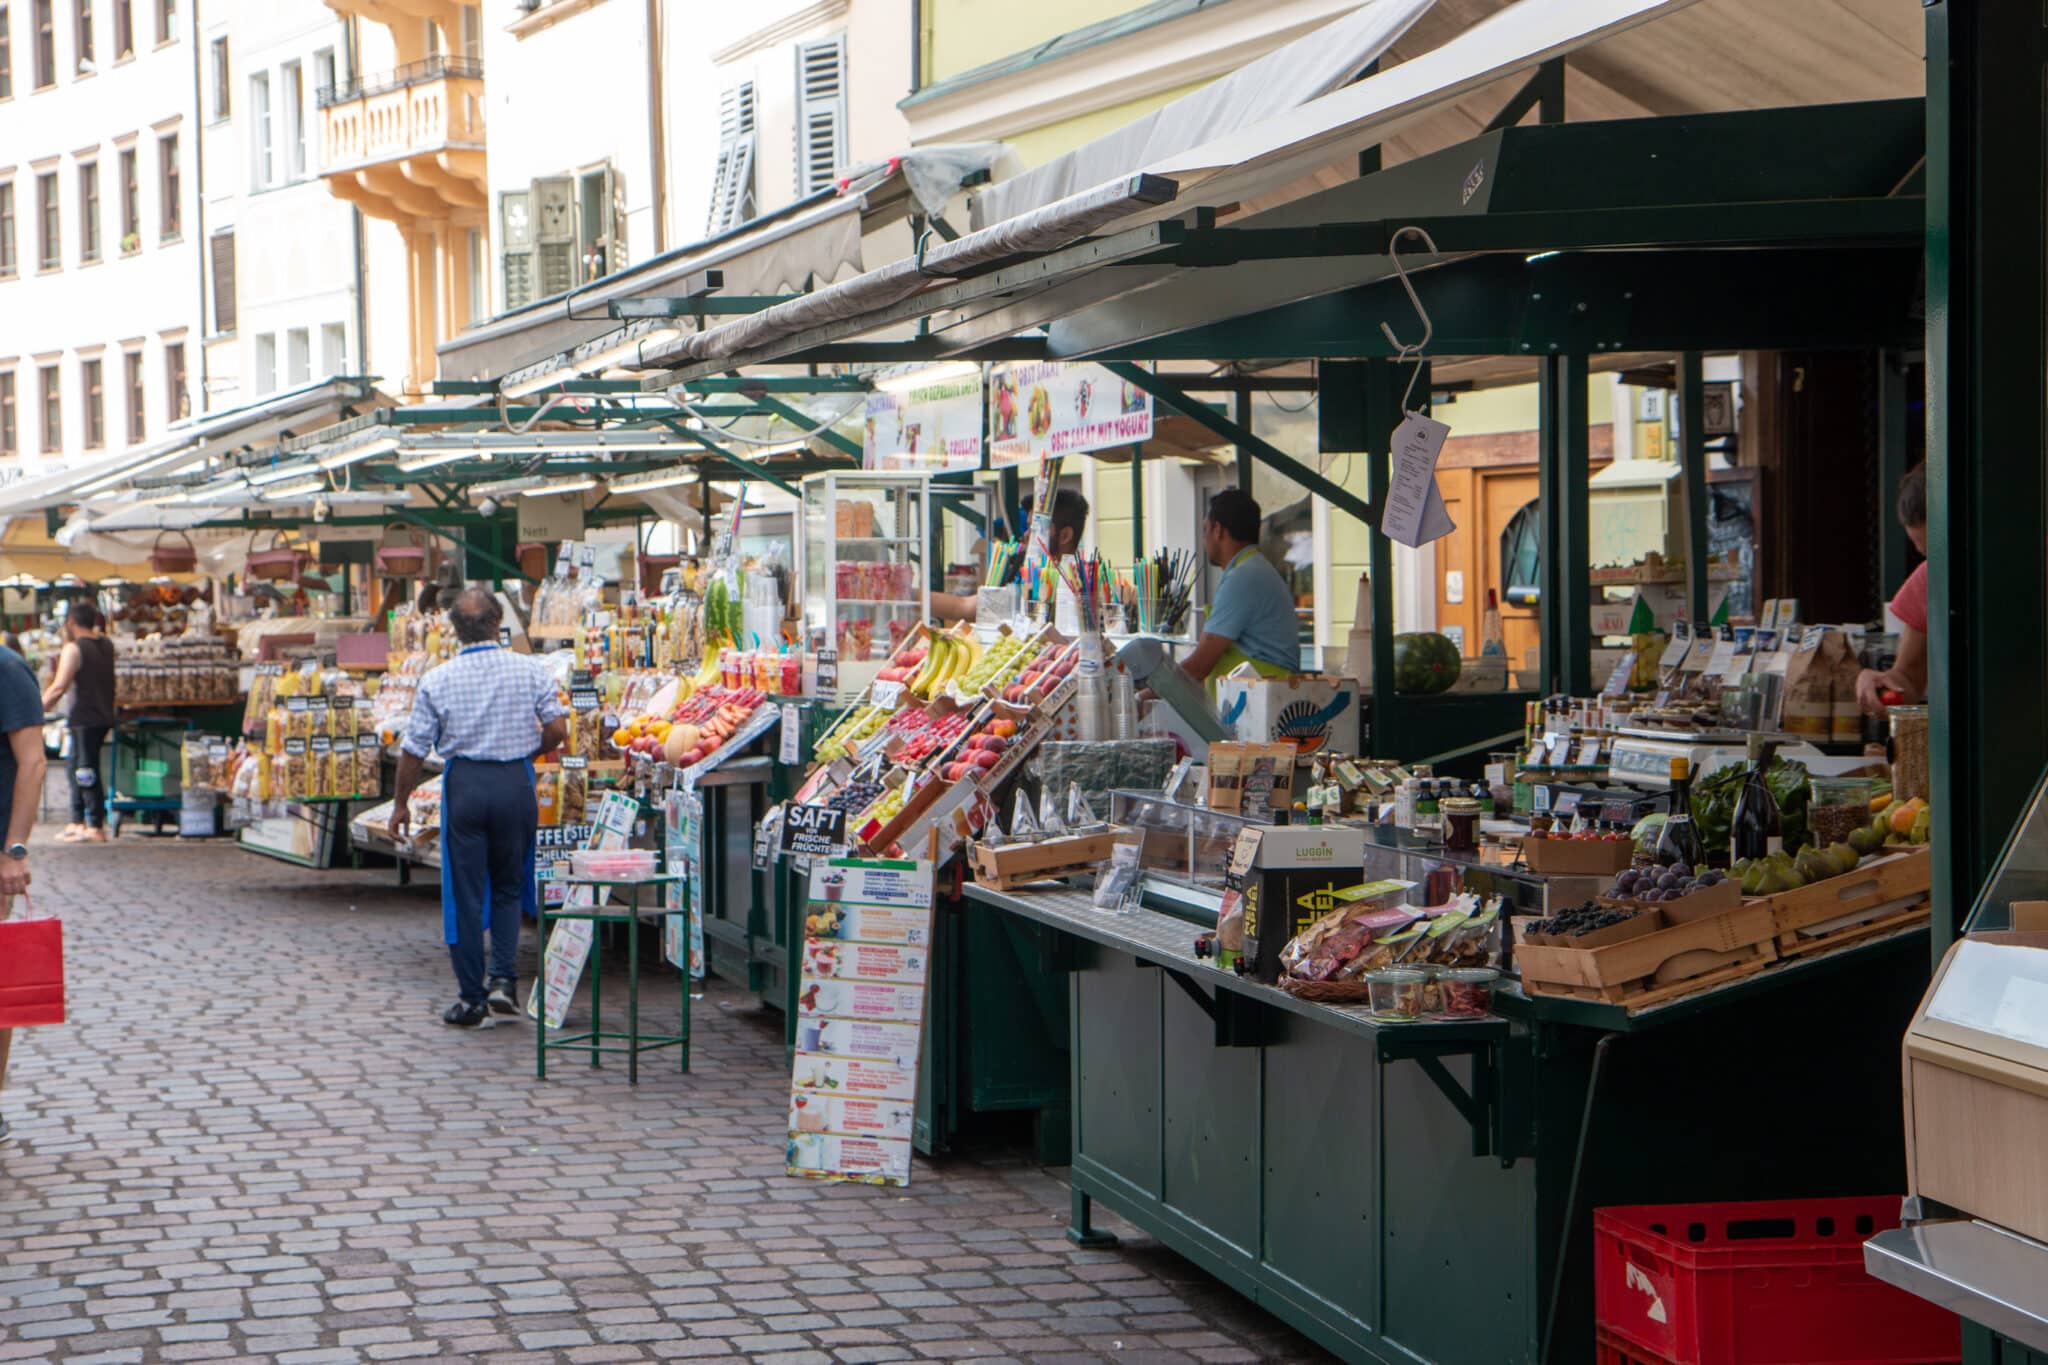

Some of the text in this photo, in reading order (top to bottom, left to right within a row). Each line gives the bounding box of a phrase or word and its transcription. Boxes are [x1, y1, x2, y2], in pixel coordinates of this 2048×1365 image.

[1051, 414, 1149, 453] OBST SALAT MIT YOGURT
[788, 806, 842, 830] SAFT
[535, 829, 572, 846] FFEL
[793, 833, 832, 845] FRISCHE
[535, 849, 569, 862] CHELN
[1296, 848, 1333, 857] LUGGIN
